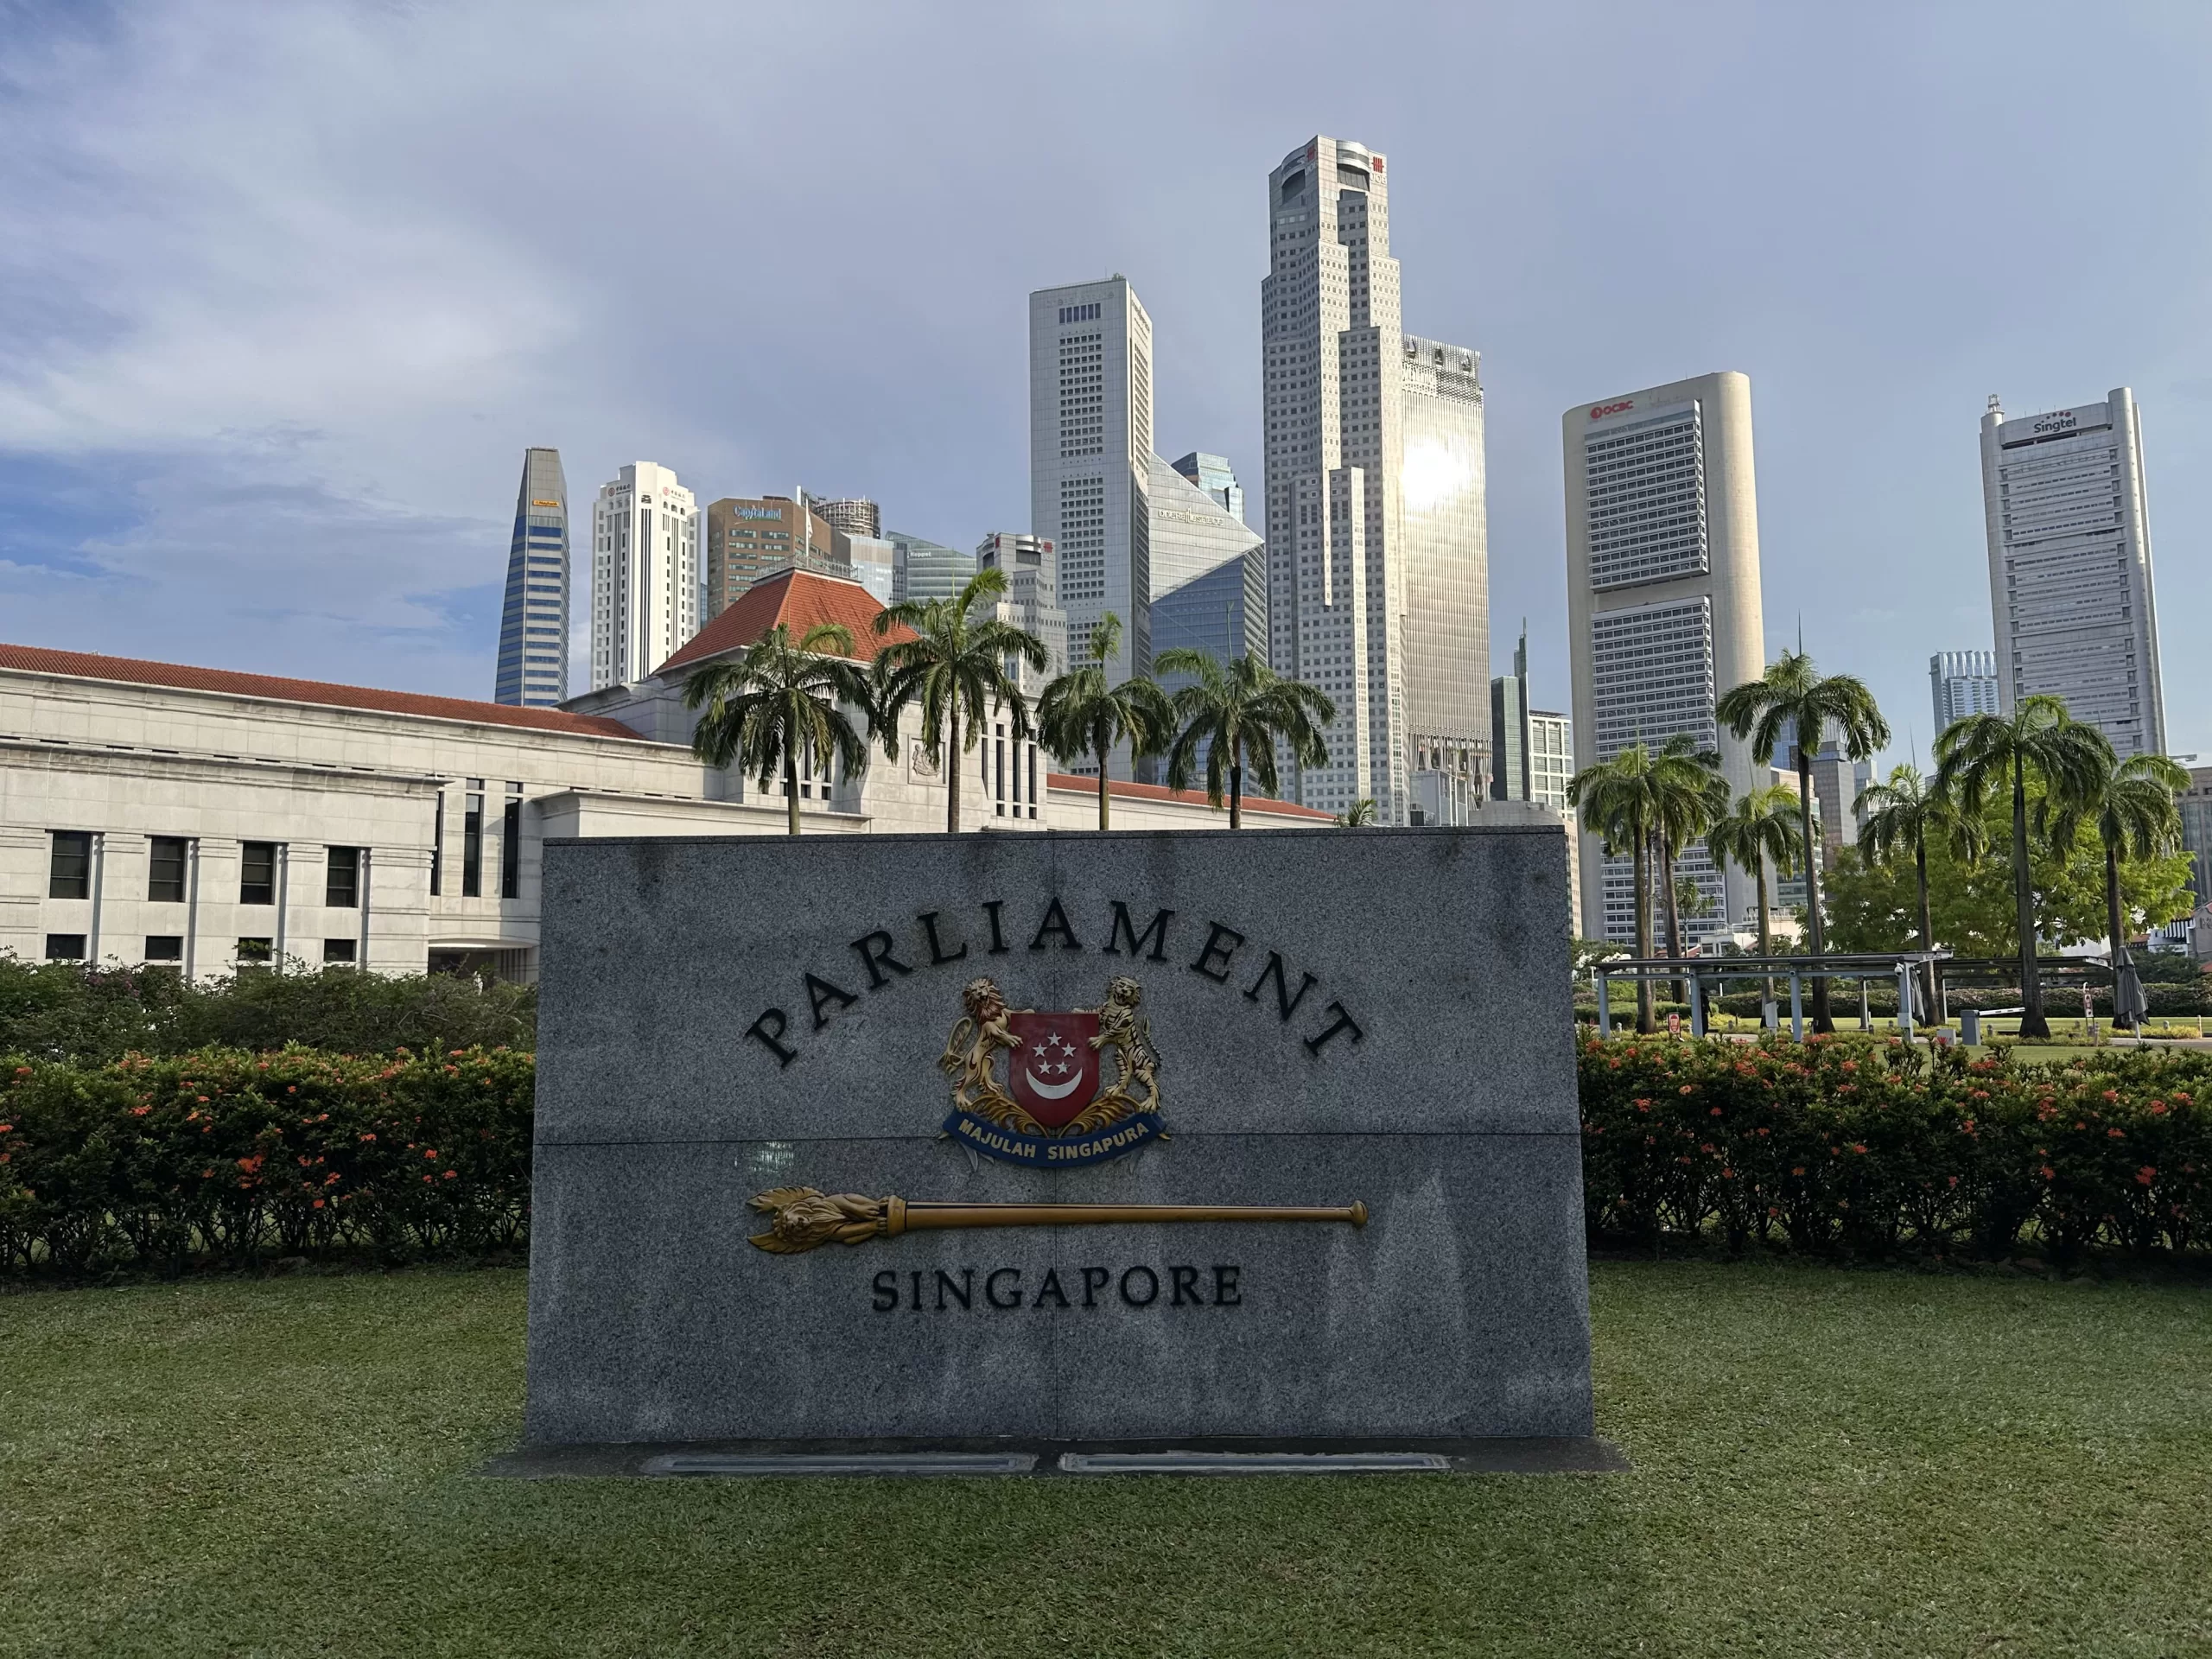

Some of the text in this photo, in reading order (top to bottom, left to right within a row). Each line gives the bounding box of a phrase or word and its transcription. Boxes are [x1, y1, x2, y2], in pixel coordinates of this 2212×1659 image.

[1604, 400, 1634, 415] OCBC
[2033, 416, 2077, 434] Singtel
[744, 896, 1364, 1069] PARLIAMENT
[958, 1118, 1149, 1160] MAJULAH SINGAPURA
[872, 1265, 1243, 1312] SINGAPORE
